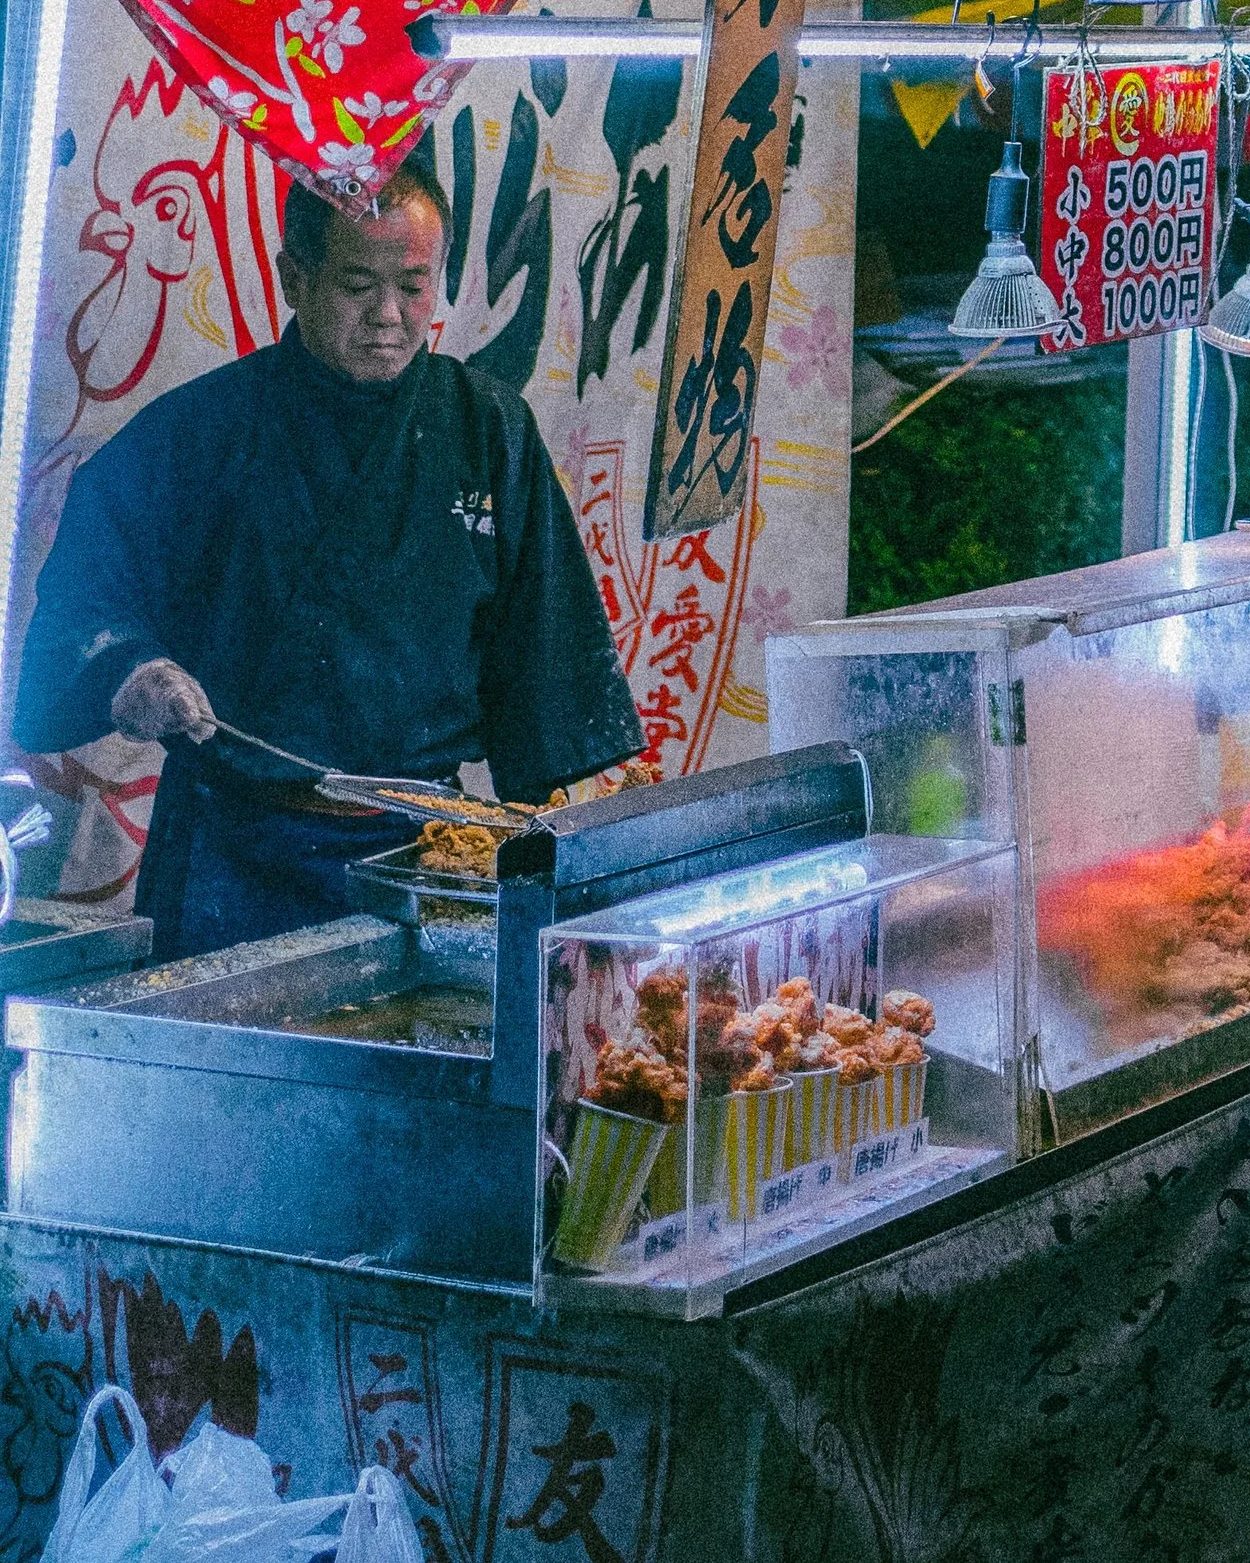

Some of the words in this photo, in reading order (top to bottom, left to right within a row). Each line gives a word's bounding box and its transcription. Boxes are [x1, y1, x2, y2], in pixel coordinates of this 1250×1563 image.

[1057, 166, 1091, 222] 小
[1105, 150, 1207, 216] 500円
[1055, 226, 1090, 284] 中
[1103, 209, 1205, 279] 800円
[1056, 286, 1087, 346] 大
[1103, 268, 1203, 337] 1000円
[506, 1401, 638, 1563] 友
